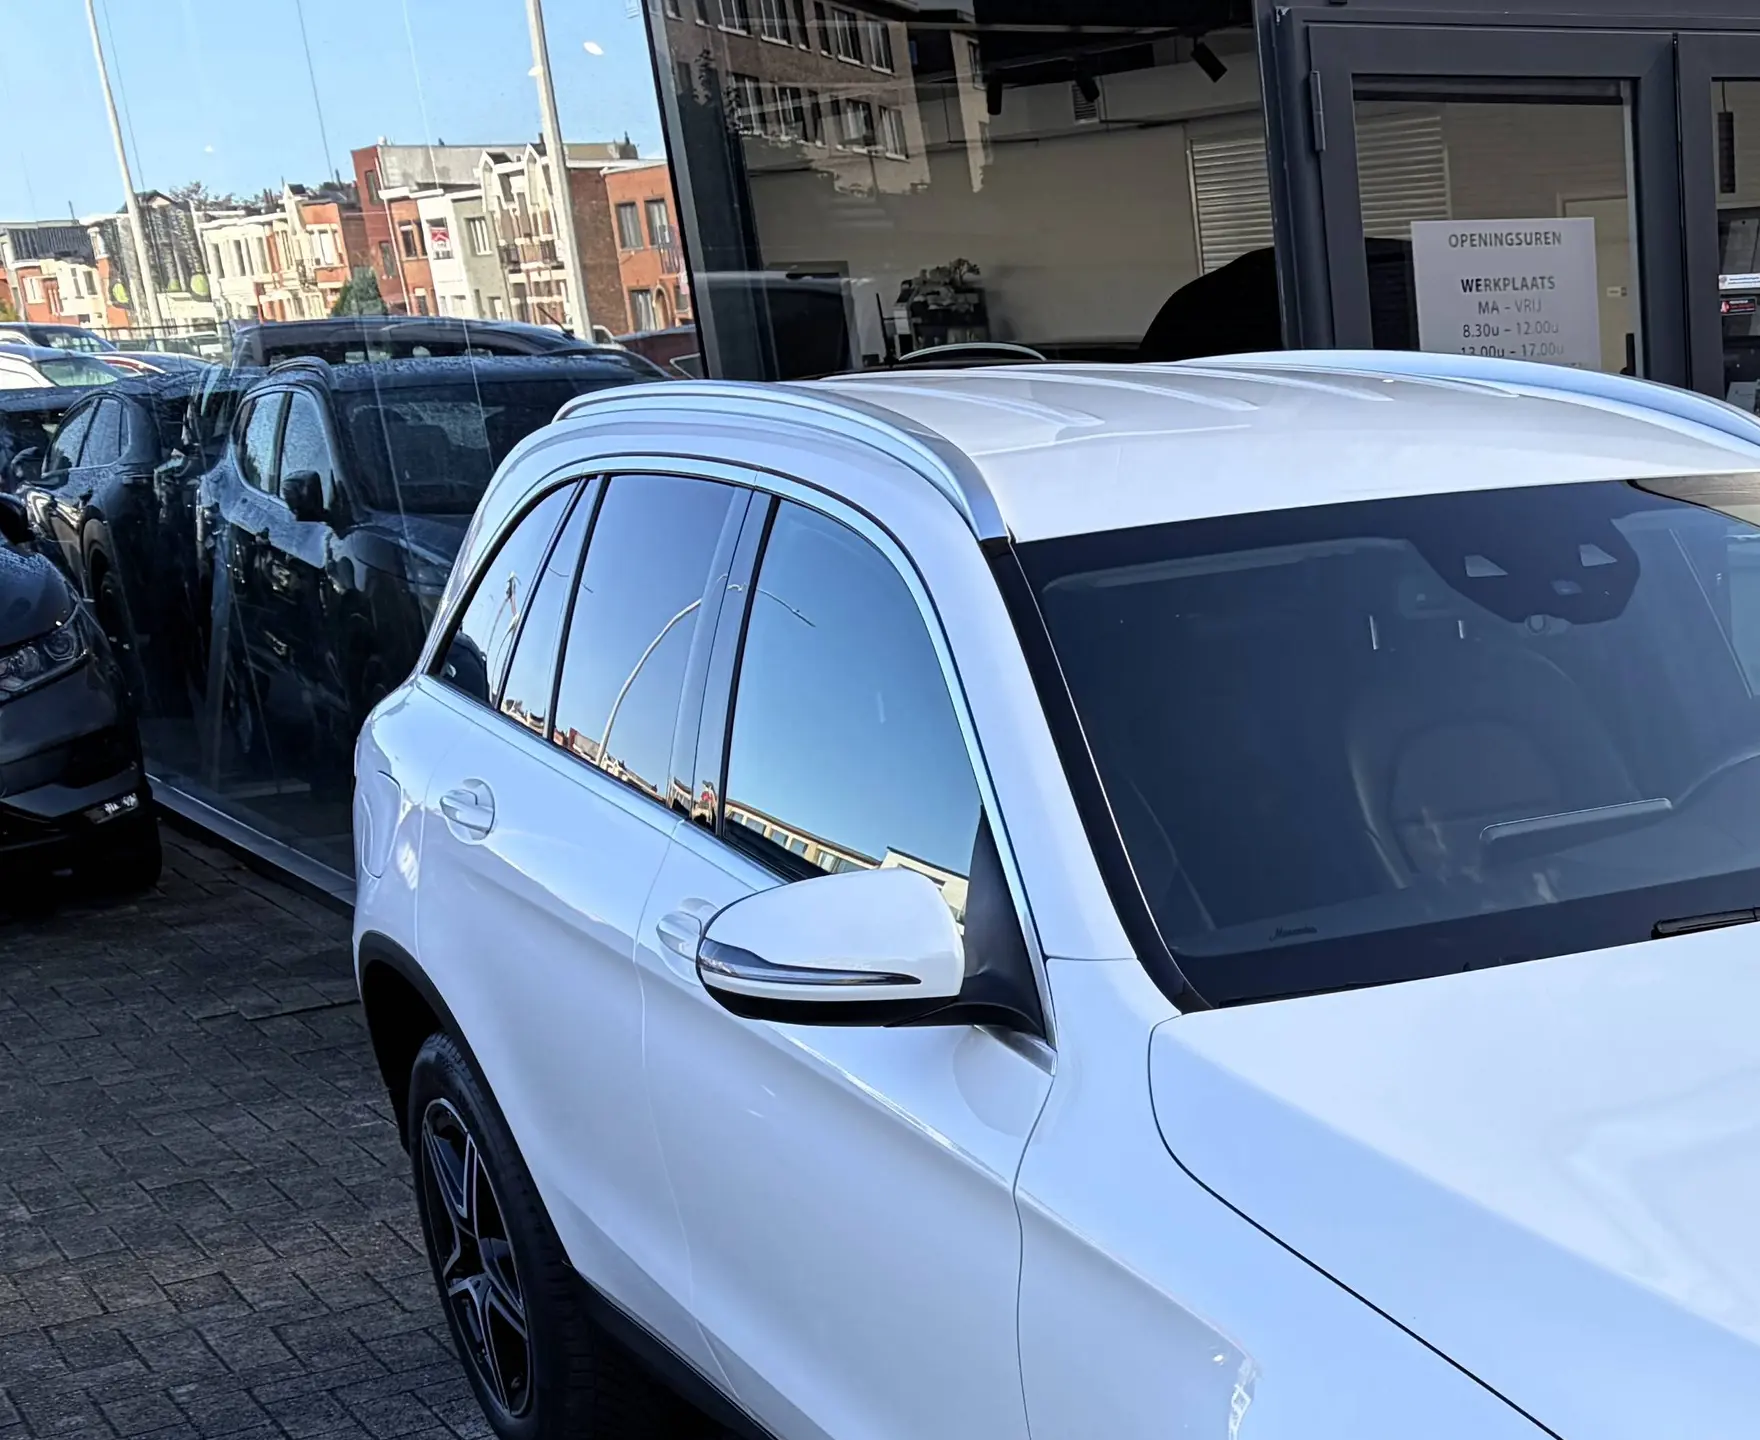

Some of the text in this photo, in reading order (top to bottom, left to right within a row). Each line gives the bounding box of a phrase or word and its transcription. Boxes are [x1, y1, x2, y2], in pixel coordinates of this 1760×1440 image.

[1448, 231, 1562, 248] OPENINGSUREN
[1461, 276, 1556, 293] WERKPLAATS
[1478, 301, 1500, 315] MA
[1515, 299, 1542, 313] VRIJ
[1463, 323, 1500, 338] 8.30u
[1516, 321, 1559, 336] 12.00u
[1521, 342, 1564, 357] 17.00u
